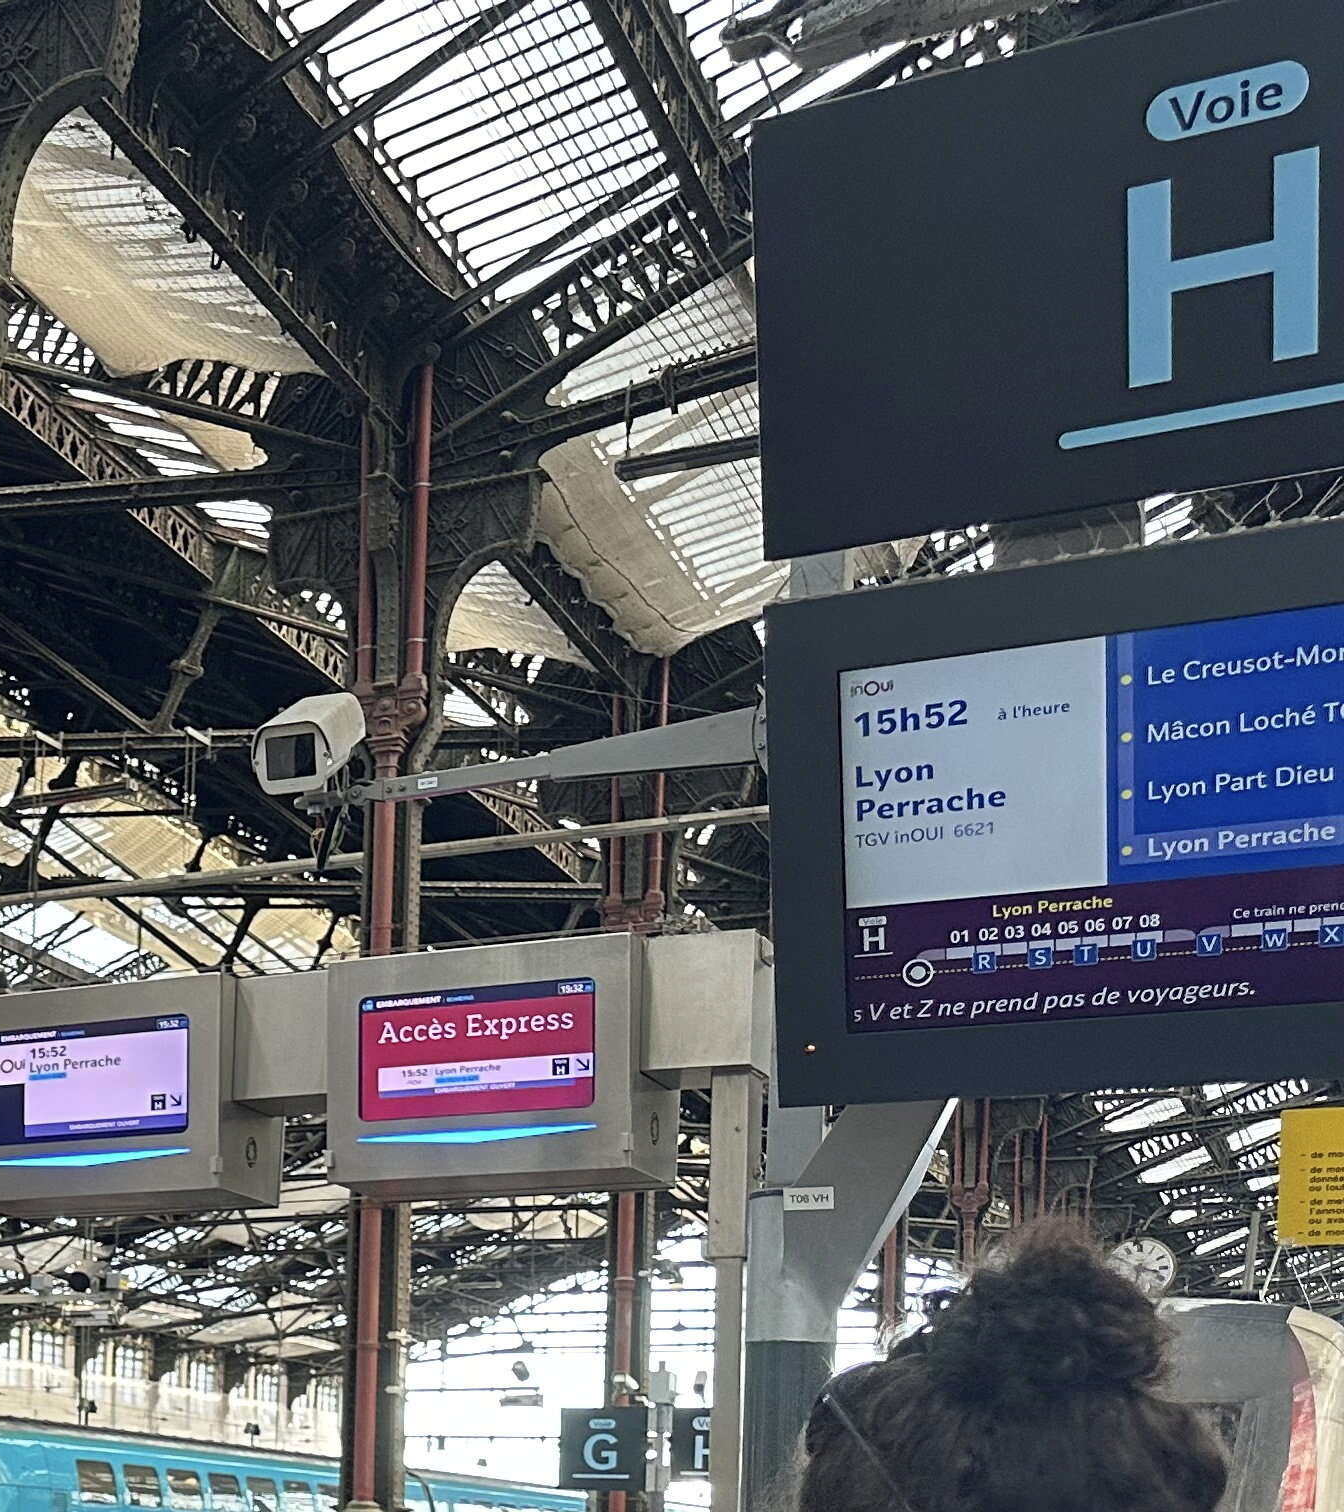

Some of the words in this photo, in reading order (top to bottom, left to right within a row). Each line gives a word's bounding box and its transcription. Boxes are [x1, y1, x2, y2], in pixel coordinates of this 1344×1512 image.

[1169, 79, 1283, 131] Voie
[1127, 146, 1319, 388] H
[1148, 666, 1175, 685] Le
[854, 700, 968, 737] 15h52
[998, 707, 1007, 720] à
[1013, 702, 1070, 718] l'heure
[1147, 719, 1229, 743] Mâcon
[1240, 704, 1315, 732] Loché
[1323, 702, 1344, 722] T
[856, 763, 934, 791] Lyon
[1148, 780, 1205, 803] Lyon
[1215, 770, 1266, 792] Part
[1276, 765, 1334, 786] Dieu
[856, 788, 1006, 821] Perrache
[855, 832, 889, 848] TGV
[954, 822, 994, 838] 6621
[1148, 837, 1208, 860] Lyon
[1218, 823, 1336, 849] Perrache
[993, 904, 1032, 918] Lyon
[1039, 896, 1112, 914] Perrache
[1233, 908, 1250, 918] Ce
[1255, 905, 1284, 917] train
[1289, 905, 1305, 914] ne
[863, 927, 885, 951] H
[950, 930, 969, 943] 01
[979, 928, 998, 941] 02
[1004, 925, 1024, 939] 03
[1031, 923, 1051, 936] 04
[1058, 921, 1078, 934] 05
[1085, 919, 1105, 932] 06
[1112, 916, 1132, 930] 07
[1139, 914, 1160, 927] 08
[979, 955, 990, 969] R
[1035, 951, 1047, 965] S
[1079, 947, 1092, 961] T
[1137, 943, 1151, 956] U
[1202, 936, 1217, 951] V
[1265, 933, 1284, 947] W
[1325, 927, 1340, 942] X
[870, 1003, 886, 1021] V
[890, 1004, 912, 1020] et
[917, 1000, 933, 1018] Z
[938, 1001, 964, 1016] ne
[970, 992, 1039, 1018] prend
[1043, 993, 1085, 1013] pas
[1092, 987, 1120, 1006] de
[1128, 981, 1256, 1006] voyageurs.
[377, 1018, 457, 1044] Accès
[466, 1012, 575, 1040] Express
[29, 1061, 60, 1075] Lyon
[64, 1056, 122, 1071] Perrache
[30, 1046, 67, 1059] 15:52
[402, 1068, 428, 1078] 15:52
[435, 1065, 457, 1076] Lyon
[459, 1062, 501, 1073] Perrache
[583, 1433, 618, 1471] G
